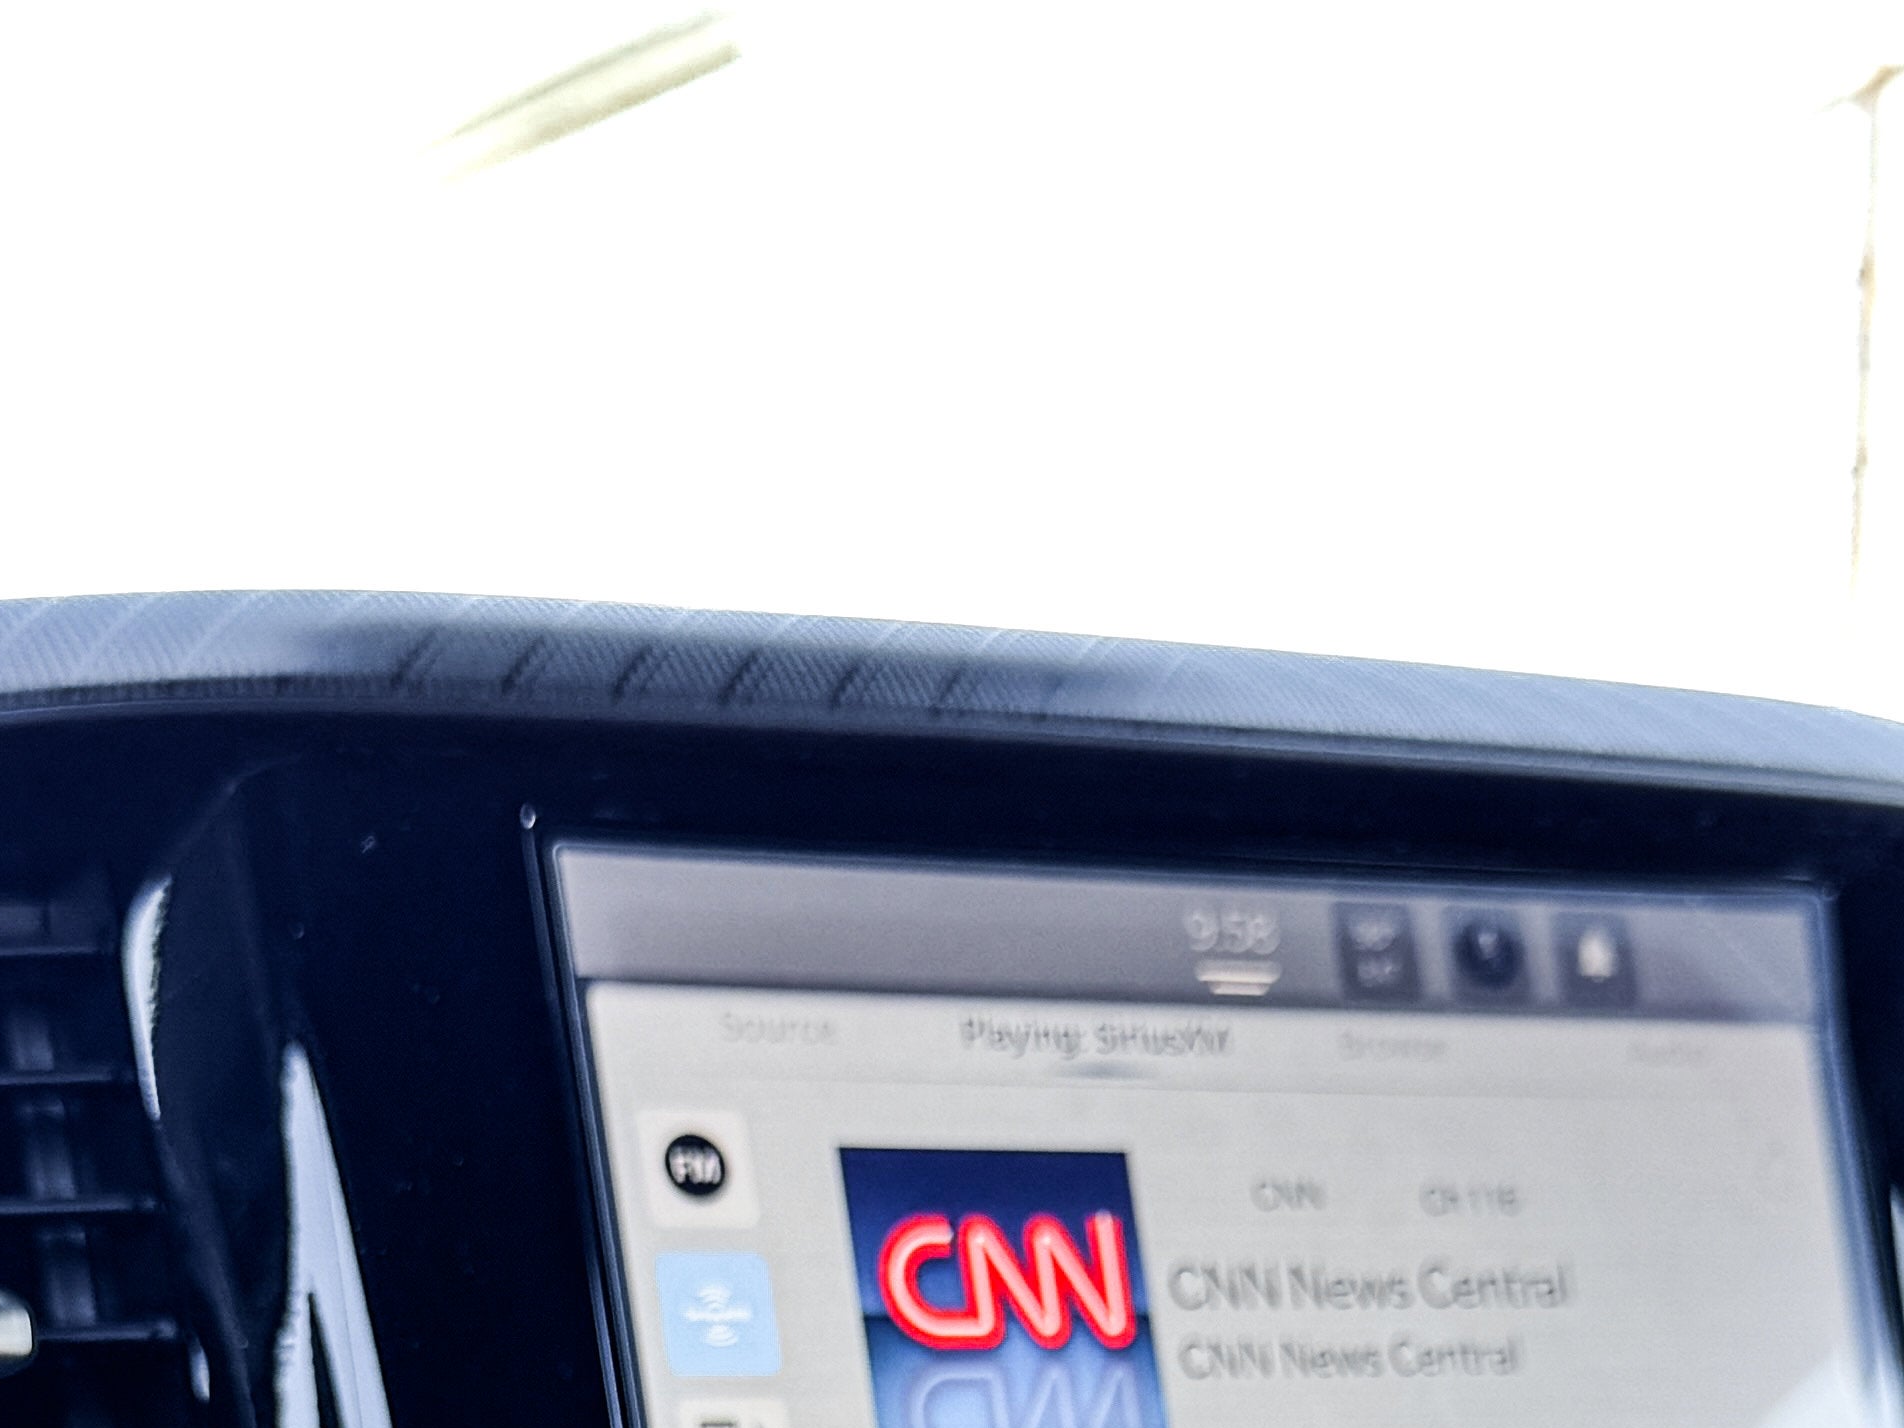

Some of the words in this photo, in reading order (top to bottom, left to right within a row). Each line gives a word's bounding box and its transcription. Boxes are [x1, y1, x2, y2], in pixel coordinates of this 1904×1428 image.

[877, 1213, 1137, 1350] CNN
[1168, 1265, 1280, 1310] CNN
[1287, 1267, 1410, 1309] News
[1418, 1261, 1574, 1310] Central
[1179, 1338, 1272, 1381] CNN
[1279, 1338, 1383, 1379] News
[1388, 1335, 1521, 1378] Central
